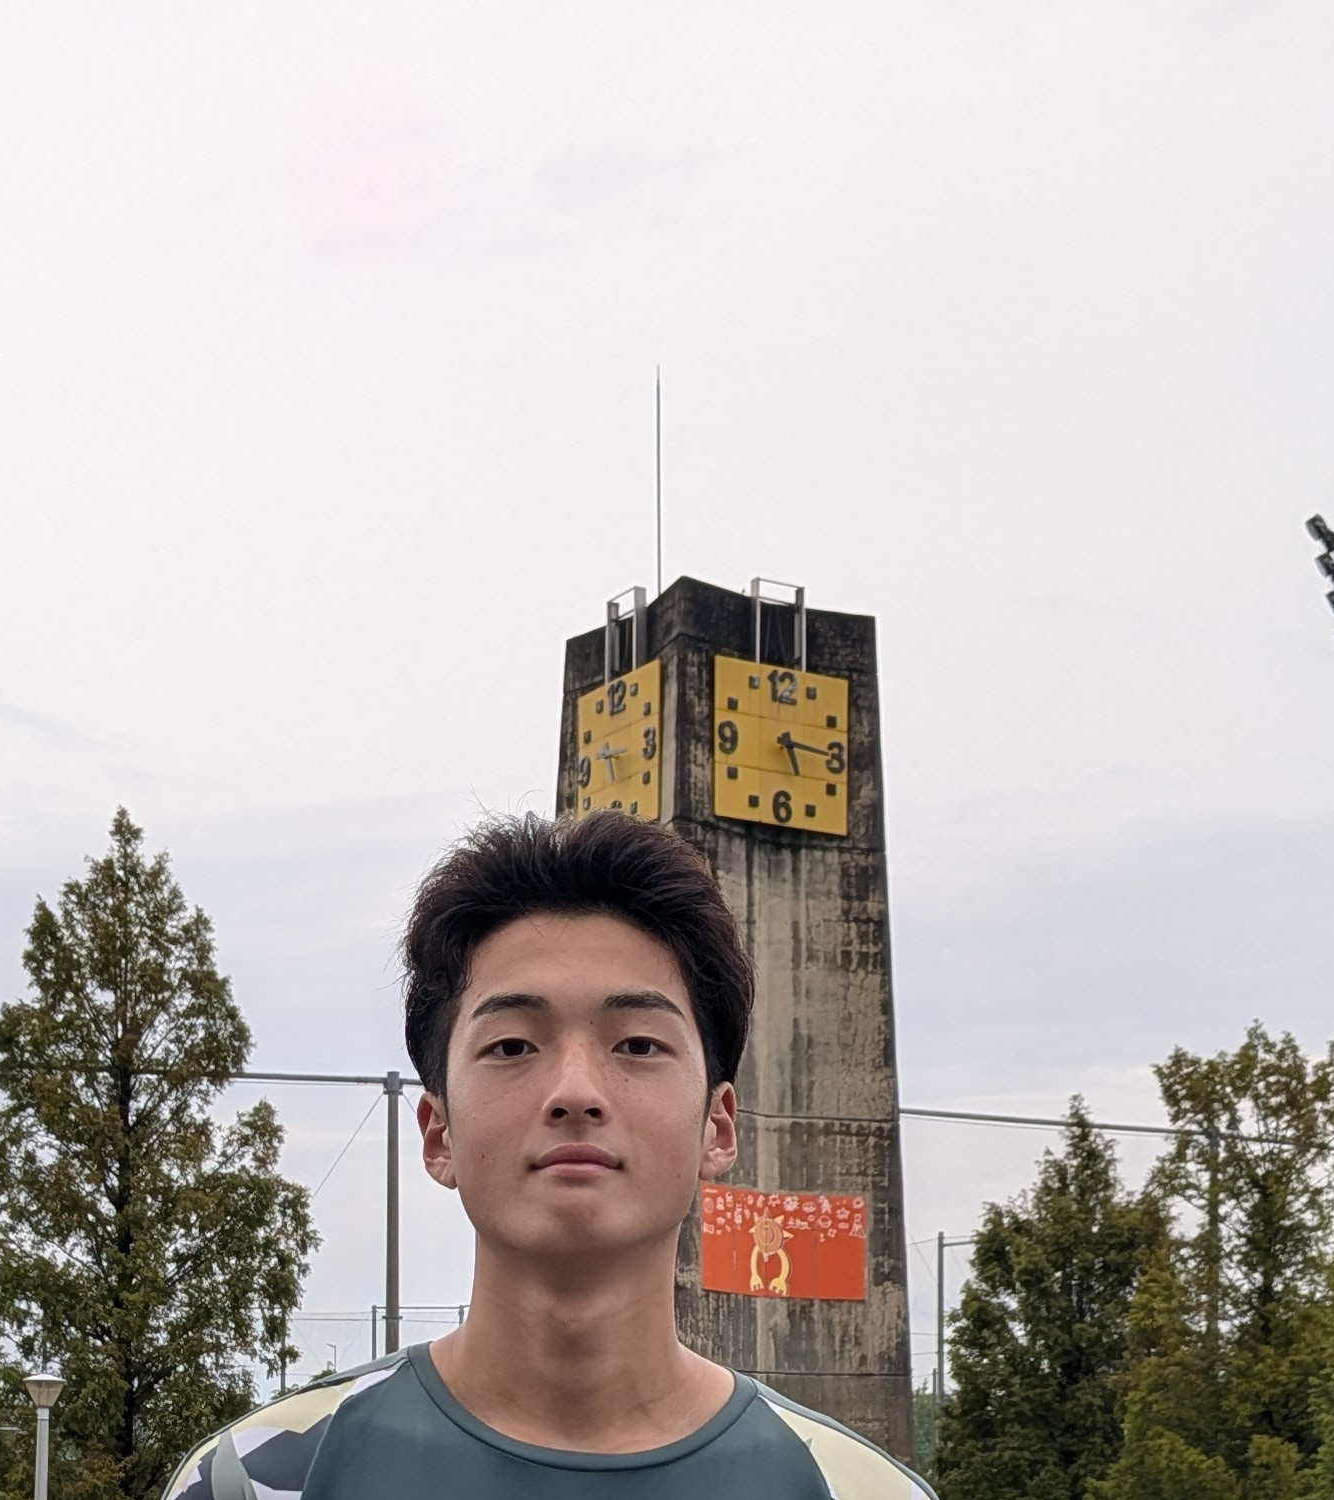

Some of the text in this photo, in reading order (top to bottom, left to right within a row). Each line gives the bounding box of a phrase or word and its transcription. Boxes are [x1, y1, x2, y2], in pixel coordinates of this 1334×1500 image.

[607, 680, 627, 716] 12
[767, 670, 798, 706] 12
[642, 726, 657, 760] 3
[718, 720, 739, 755] 9
[578, 756, 592, 788] 9
[825, 741, 846, 774] 3
[772, 790, 793, 823] 6
